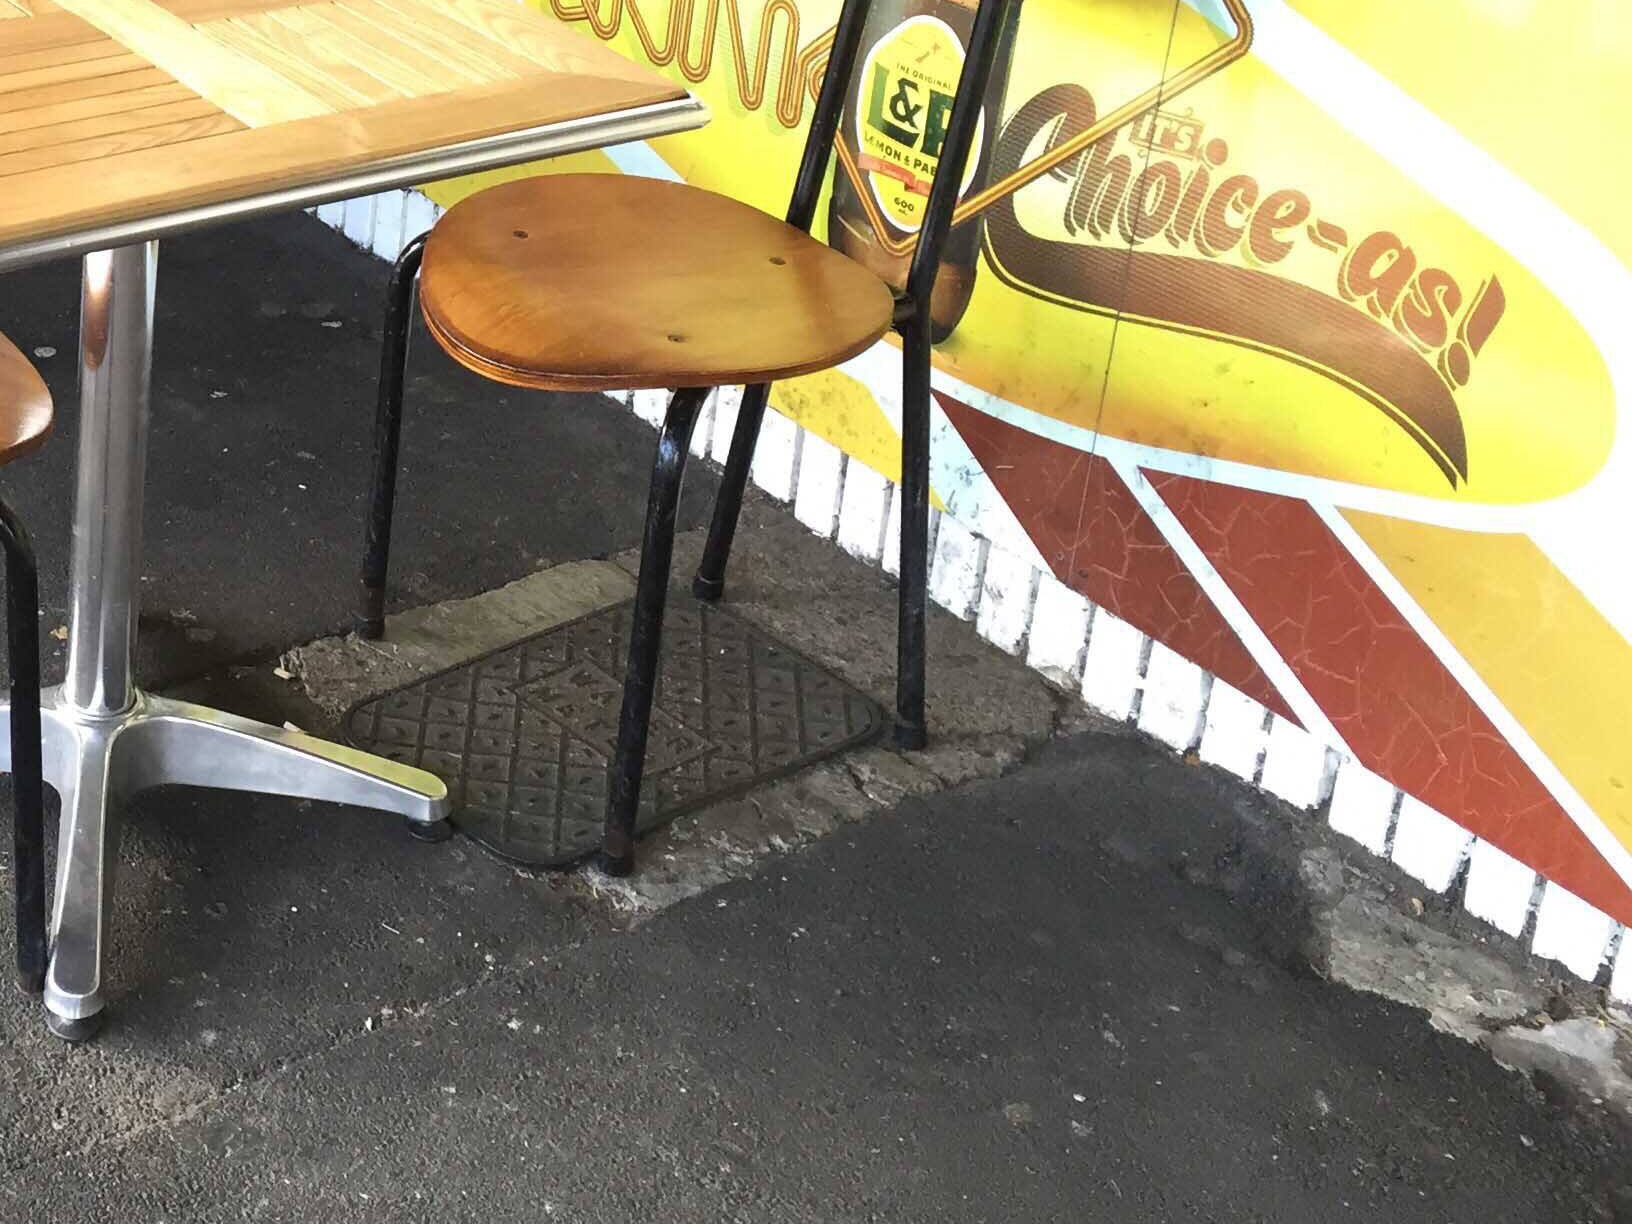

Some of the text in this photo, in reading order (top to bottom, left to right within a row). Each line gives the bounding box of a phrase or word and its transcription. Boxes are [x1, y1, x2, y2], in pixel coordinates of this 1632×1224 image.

[896, 62, 953, 91] THE ORIGINAL
[864, 130, 902, 162] LEMON
[894, 196, 914, 213] 600
